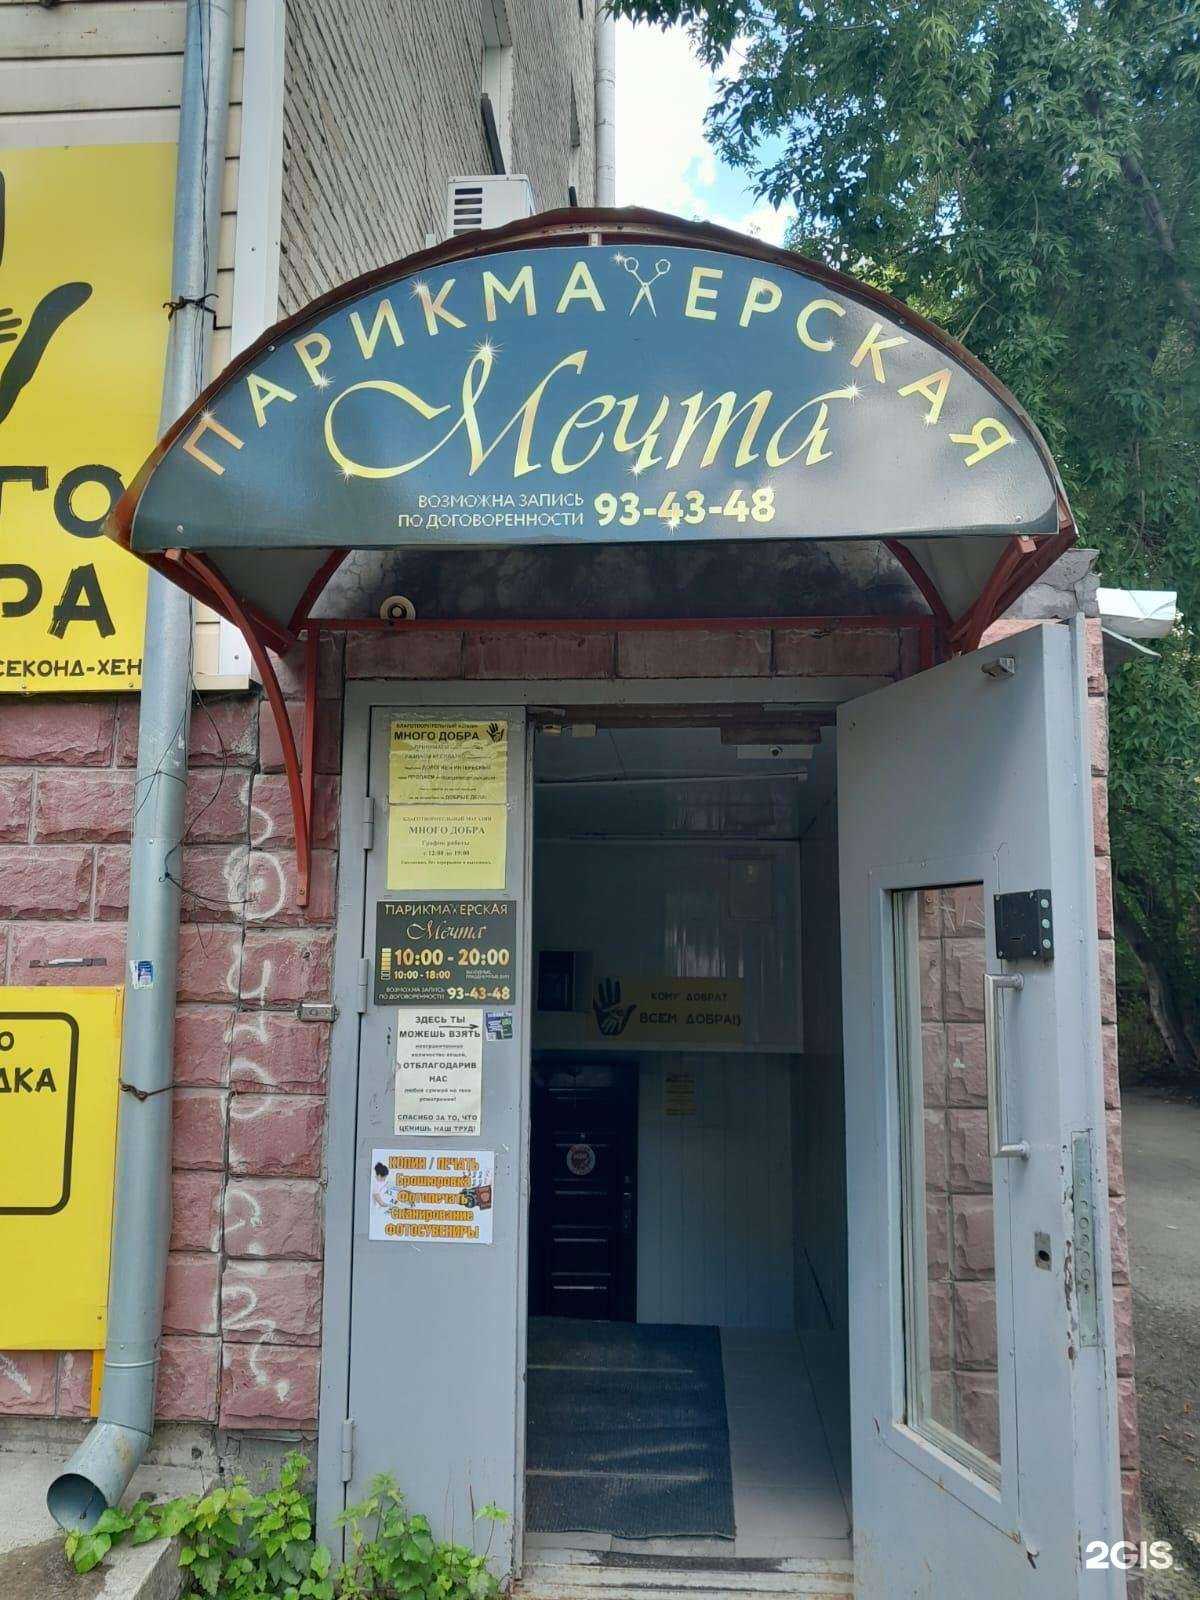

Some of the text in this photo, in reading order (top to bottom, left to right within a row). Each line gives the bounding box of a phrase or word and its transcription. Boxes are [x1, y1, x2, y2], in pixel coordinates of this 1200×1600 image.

[324, 345, 858, 479] Мечта
[418, 492, 584, 509] ВОЗМОЖНА ЗАПИСЬ
[594, 487, 776, 527] 93-43-48
[398, 512, 584, 530] ПО ДОГОВОРЕННОСТИ
[0, 657, 142, 678] ЕКОНД-ХЕН
[394, 731, 480, 742] МНОГО ДОБРА
[408, 826, 486, 836] МНОГО ДОБРА
[394, 948, 444, 966] 10:00
[457, 948, 510, 966] 20:00
[393, 970, 419, 980] 10:00
[424, 970, 451, 980] 18:00
[447, 985, 510, 1000] 93-43-48
[415, 1015, 466, 1024] ЗДЕСЬ ТЫ
[640, 1012, 678, 1024] ВСЕМ
[399, 1030, 481, 1038] МОЖЕШЬ ВЗЯТЬ
[403, 1062, 477, 1070] ОТБЛАГОДАРИВ
[429, 1075, 448, 1083] НАС
[397, 1113, 434, 1121] СПАСИБО
[447, 1114, 460, 1122] ТО,
[399, 1125, 431, 1133] ЦЕНИШЬ
[436, 1157, 480, 1171] ПЕЧАТЬ
[390, 1206, 474, 1222] Сканирование
